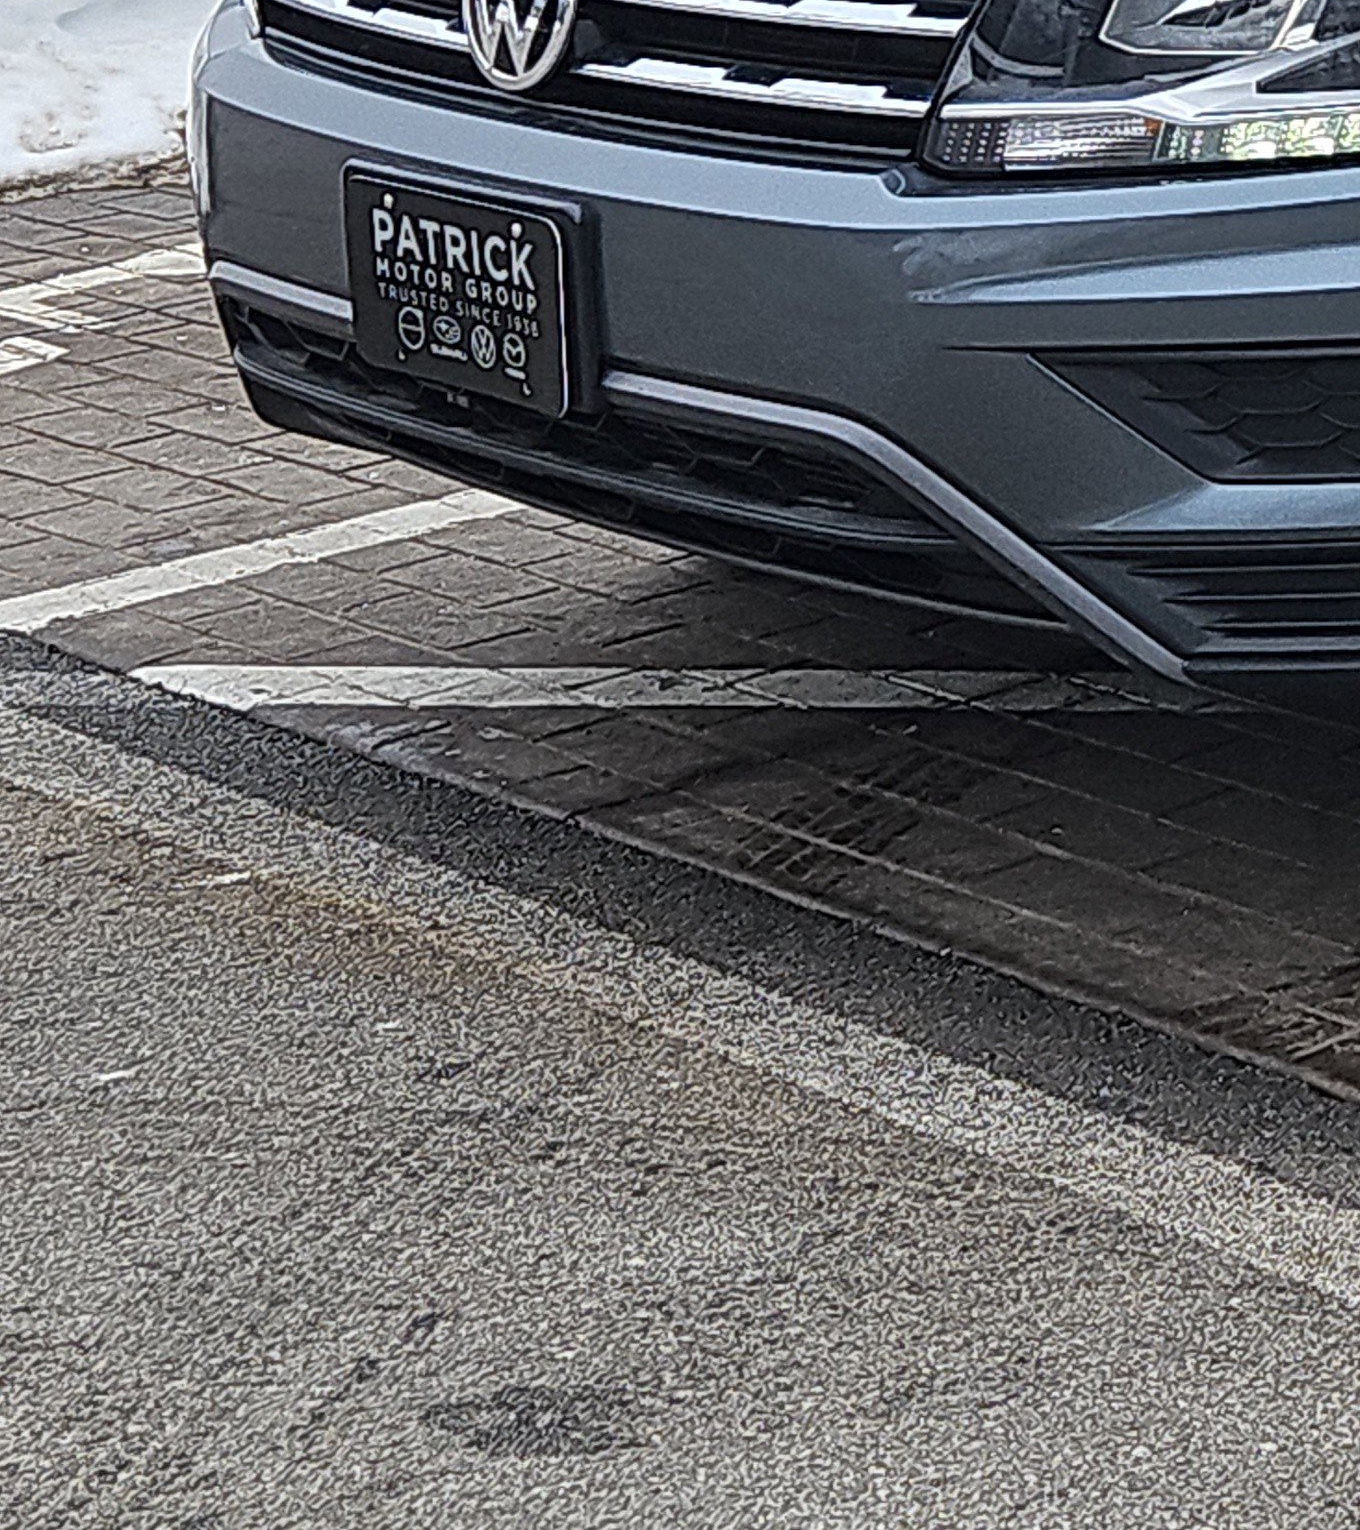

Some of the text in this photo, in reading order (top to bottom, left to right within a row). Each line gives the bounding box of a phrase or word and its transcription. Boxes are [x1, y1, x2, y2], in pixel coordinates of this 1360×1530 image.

[372, 208, 535, 291] PATRICK
[376, 257, 537, 315] MOTOR GROUP
[377, 281, 449, 313] TRUSTED
[456, 299, 502, 327] SINCE
